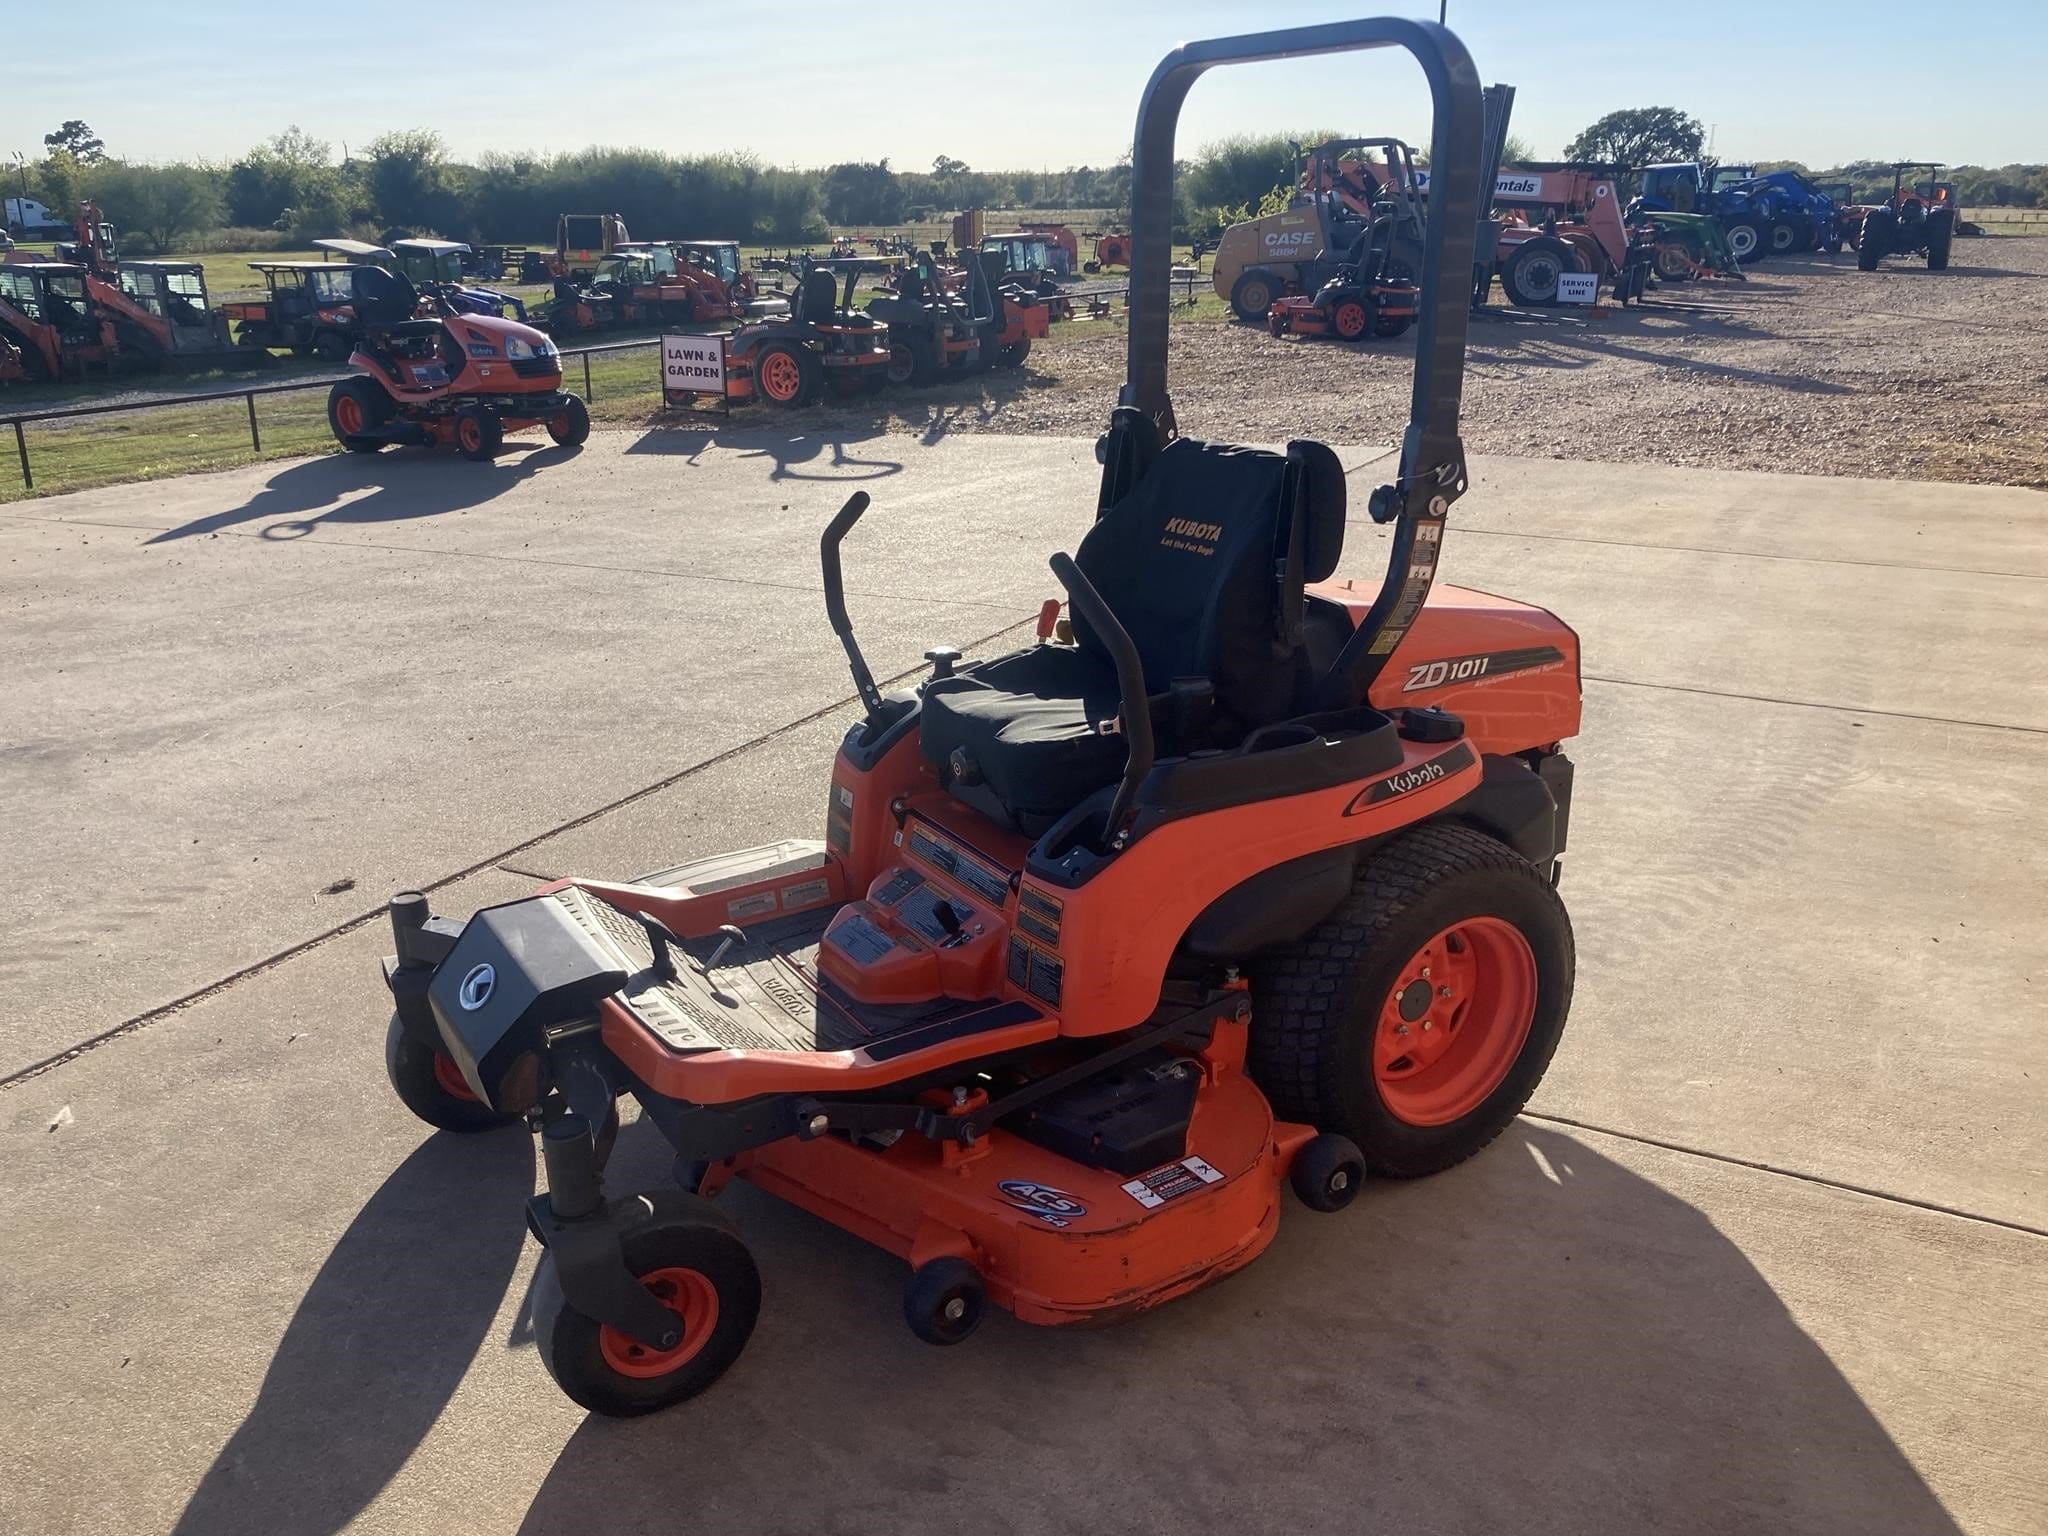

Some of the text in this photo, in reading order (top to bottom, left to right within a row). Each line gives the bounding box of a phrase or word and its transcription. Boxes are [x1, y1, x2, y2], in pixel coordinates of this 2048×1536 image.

[1497, 180, 1535, 193] ntals
[1264, 231, 1316, 246] CASE
[668, 349, 719, 362] LAWN &
[667, 365, 720, 378] GARDEN
[1164, 517, 1223, 542] KUBOTA
[1387, 763, 1445, 793] Kubota
[762, 978, 811, 1016] KUBOTA
[1010, 1185, 1080, 1211] ACS
[1040, 1214, 1070, 1228] 54
